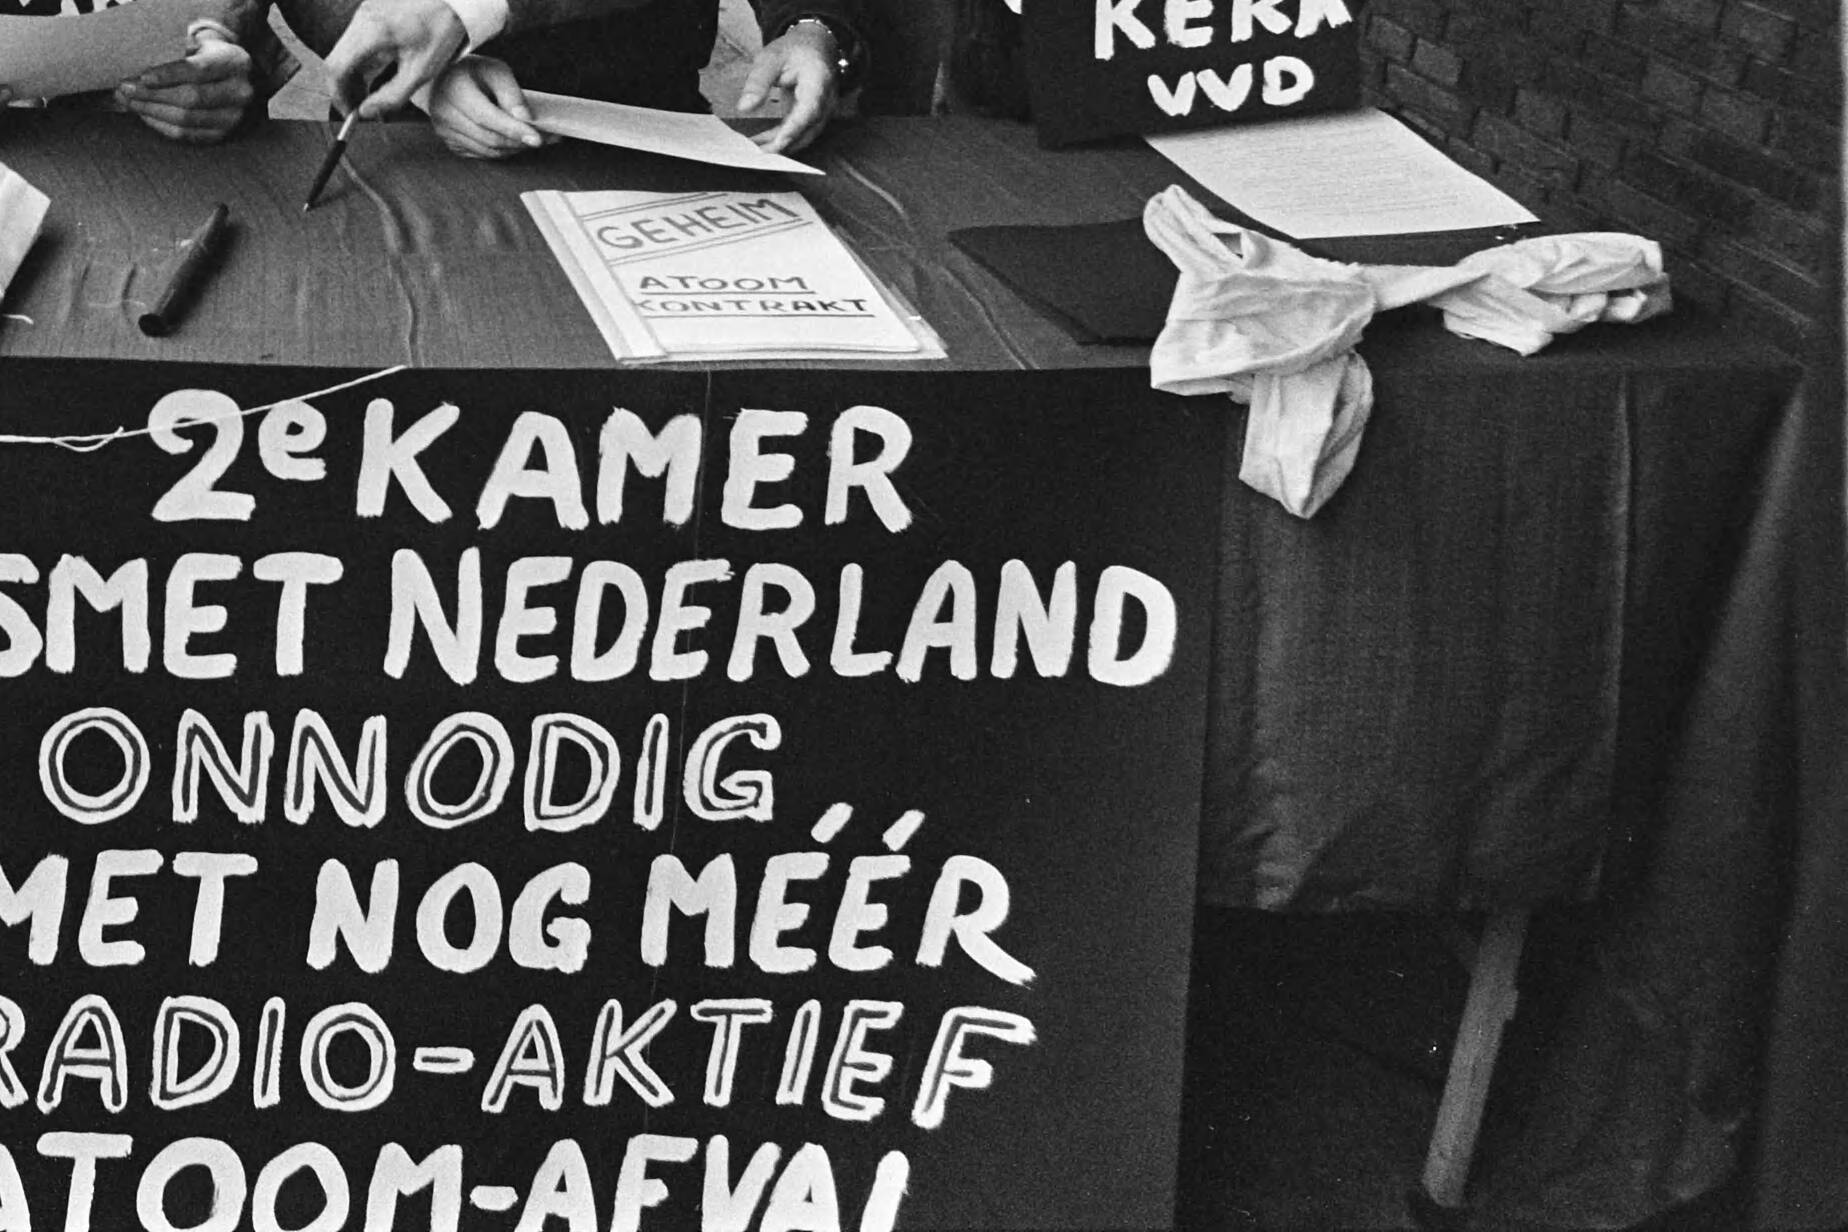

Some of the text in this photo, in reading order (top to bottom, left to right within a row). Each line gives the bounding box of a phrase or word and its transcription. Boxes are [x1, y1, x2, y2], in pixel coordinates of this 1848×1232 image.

[1147, 55, 1315, 117] VVD
[596, 197, 799, 249] GEHEIM
[633, 298, 868, 313] KONTRAKT
[639, 275, 808, 291] ATOOM
[150, 387, 913, 534] 2e KAMER
[383, 546, 1178, 687] NEDERLAND
[38, 706, 782, 833] ONNODIG
[306, 858, 592, 975] NOG
[640, 802, 1038, 986] MÉÉR
